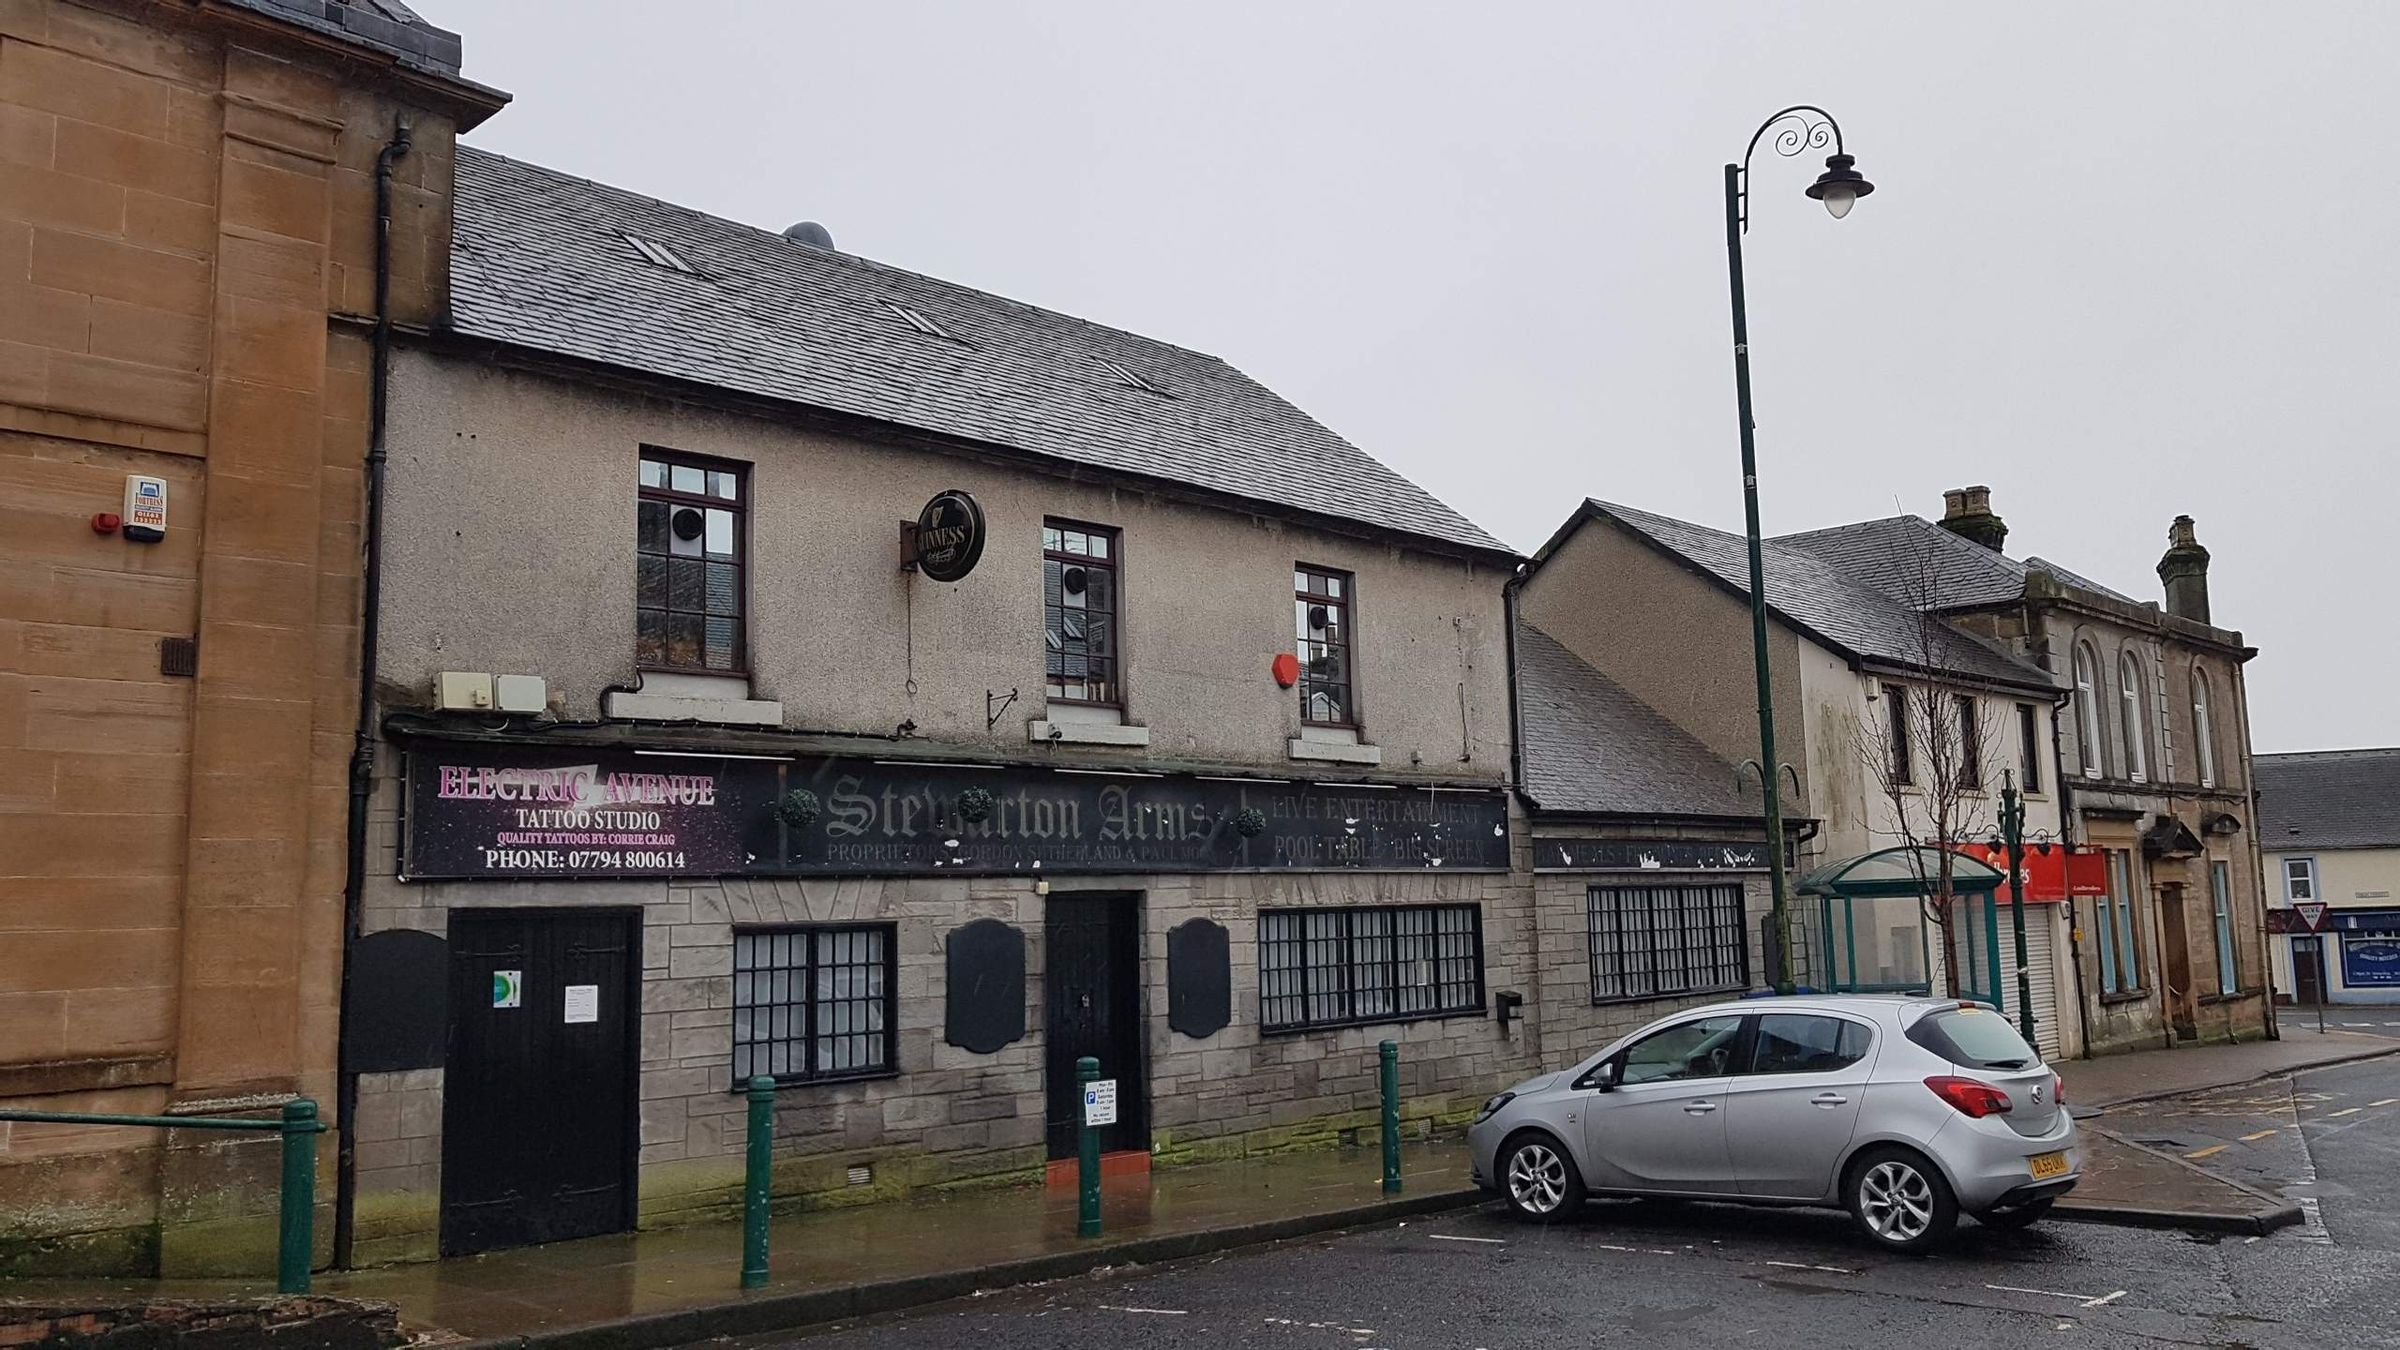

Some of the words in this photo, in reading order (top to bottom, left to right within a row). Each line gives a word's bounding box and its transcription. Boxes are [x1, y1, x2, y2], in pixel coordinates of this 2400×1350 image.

[917, 525, 965, 552] UINNESS
[438, 765, 589, 802] ELECTRIC
[602, 771, 715, 806] AVENUE
[516, 808, 590, 830] TATTOO
[594, 810, 660, 831] STUDIO
[1099, 783, 1216, 841] Arms
[1272, 796, 1318, 818] LIVE
[1325, 797, 1481, 825] ENTERTAINMENT
[497, 832, 543, 845] QUALITY
[545, 833, 590, 845] TATTOOS
[592, 834, 607, 845] BY:
[608, 833, 645, 846] CORRIE
[646, 834, 675, 846] CRAIG
[1275, 834, 1320, 859] POOL
[1325, 836, 1384, 861] TABLE
[485, 850, 565, 869] PHONE:
[569, 851, 622, 869] 07794
[625, 851, 685, 869] 800614
[2302, 906, 2319, 914] GIVE
